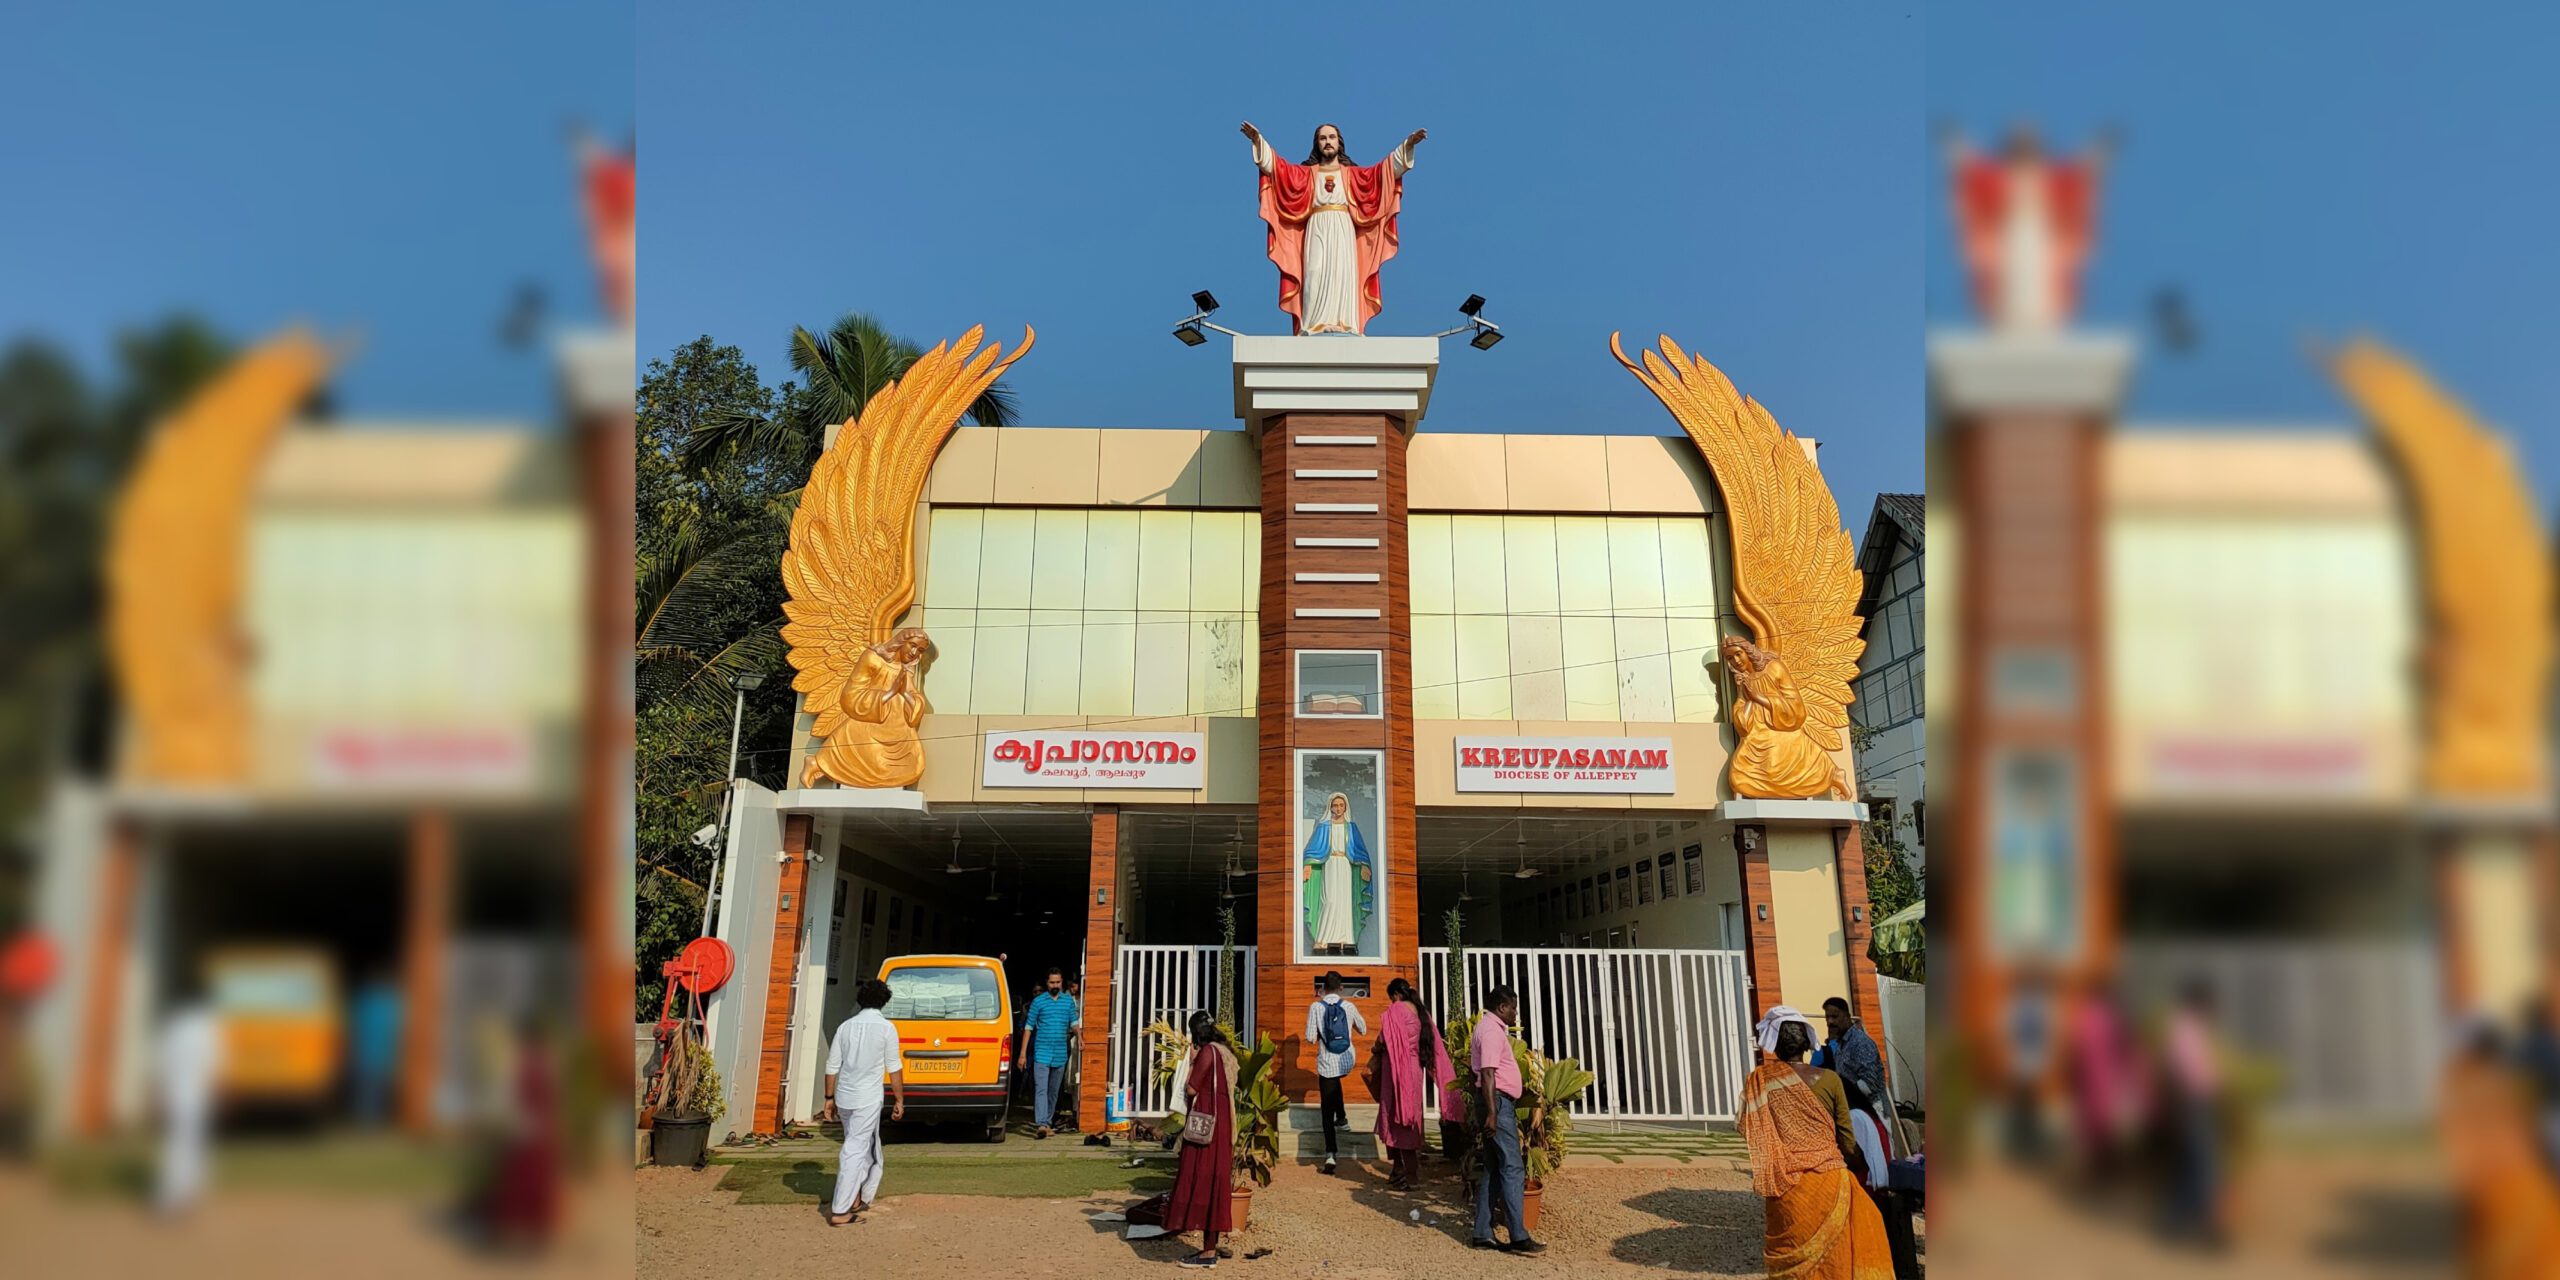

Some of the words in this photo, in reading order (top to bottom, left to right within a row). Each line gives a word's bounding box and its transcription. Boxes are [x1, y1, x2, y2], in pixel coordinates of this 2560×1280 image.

[993, 739, 1197, 772] കൃപാസനം
[1460, 747, 1669, 769] KREUPASANAM
[1494, 770, 1549, 780] DIOCESE
[1553, 771, 1570, 780] OF
[1574, 772, 1638, 781] ALLEPPEY
